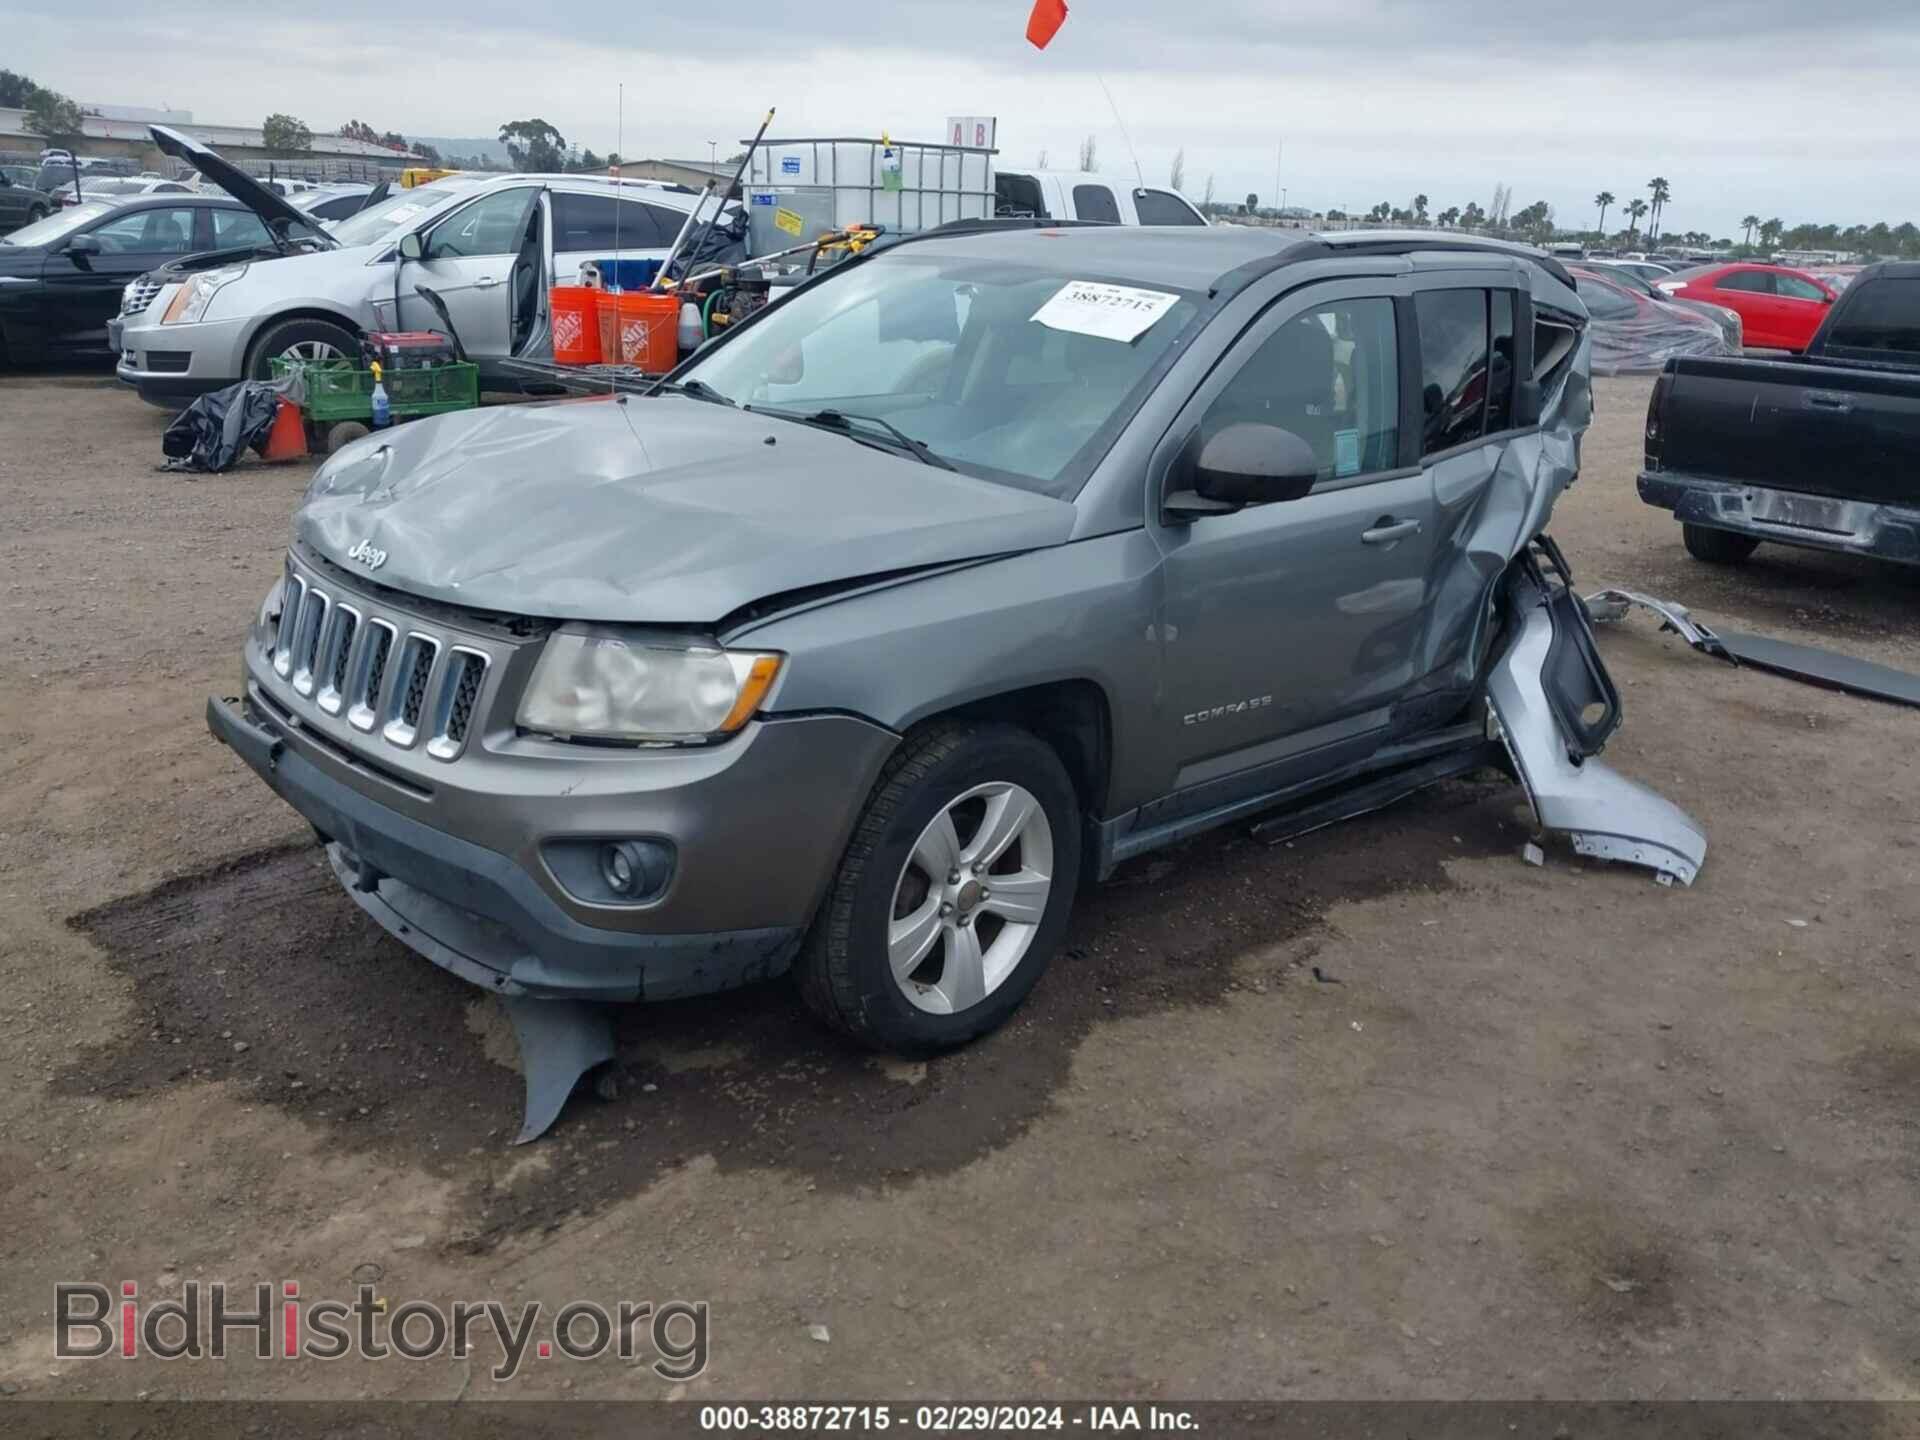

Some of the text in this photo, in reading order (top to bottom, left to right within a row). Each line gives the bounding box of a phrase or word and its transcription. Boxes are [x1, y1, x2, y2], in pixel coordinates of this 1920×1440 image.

[953, 123, 962, 146] A
[976, 123, 985, 147] B
[348, 539, 387, 570] Jeep
[1183, 695, 1272, 725] COMPASS
